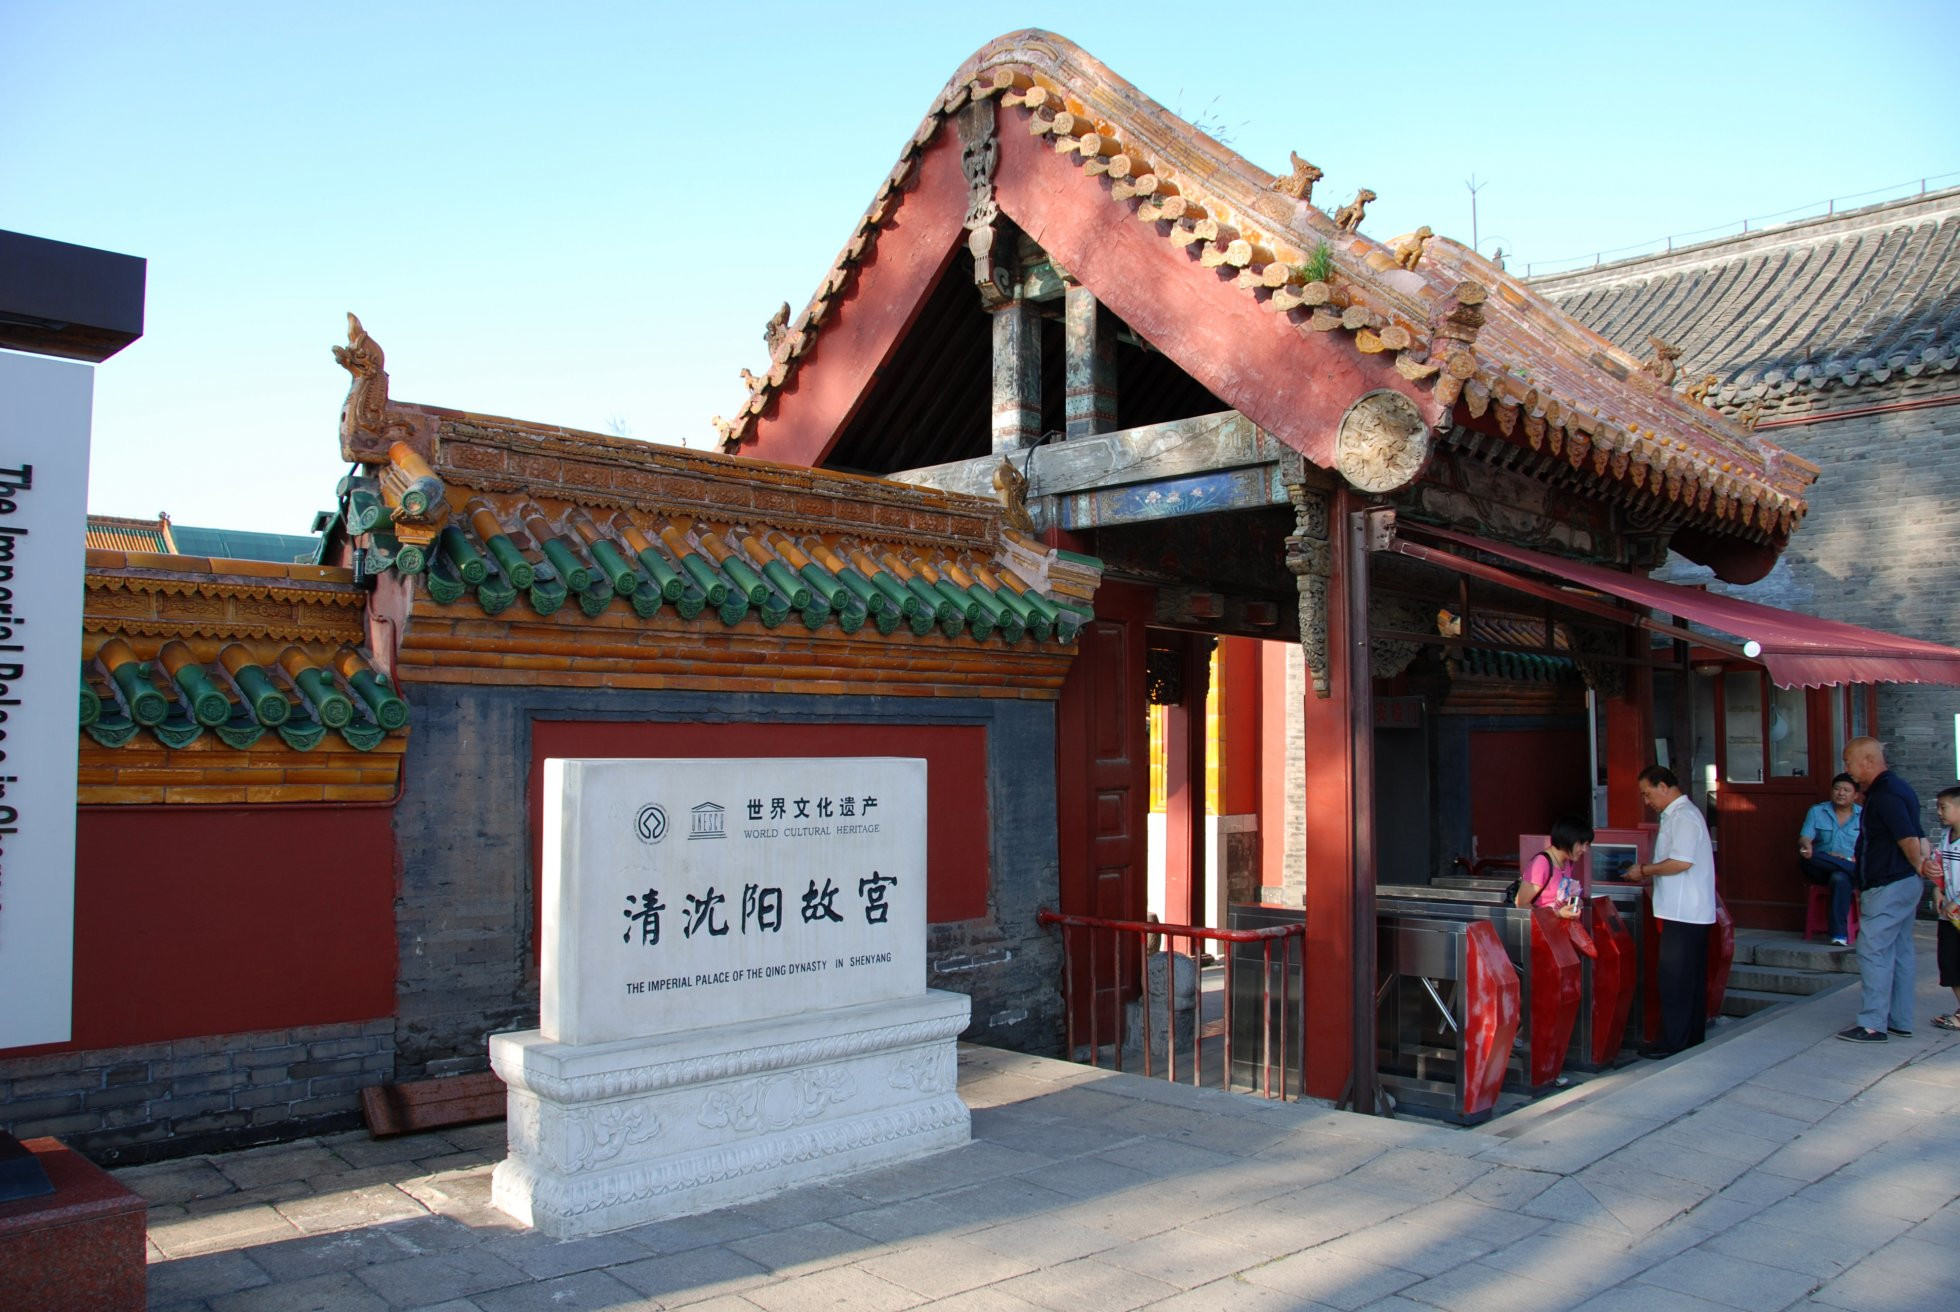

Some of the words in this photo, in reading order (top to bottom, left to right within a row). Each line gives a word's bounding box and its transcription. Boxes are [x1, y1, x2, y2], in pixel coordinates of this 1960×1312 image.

[746, 796, 879, 821] 世界文化遗产
[691, 813, 726, 832] UNESCO
[743, 829, 779, 839] WORLD
[783, 826, 831, 837] CULTURAL
[836, 823, 880, 835] HERITAGE
[623, 870, 898, 947] 清沈阳故宫
[626, 982, 645, 995] THE
[647, 976, 692, 993] IMPERIAL
[695, 972, 730, 986] PALACE
[732, 969, 743, 981] OF
[746, 967, 763, 979] THE
[765, 964, 786, 978] QING
[788, 960, 827, 975] DYNASTY
[835, 959, 844, 969] IN
[850, 952, 892, 967] SHENYANG
